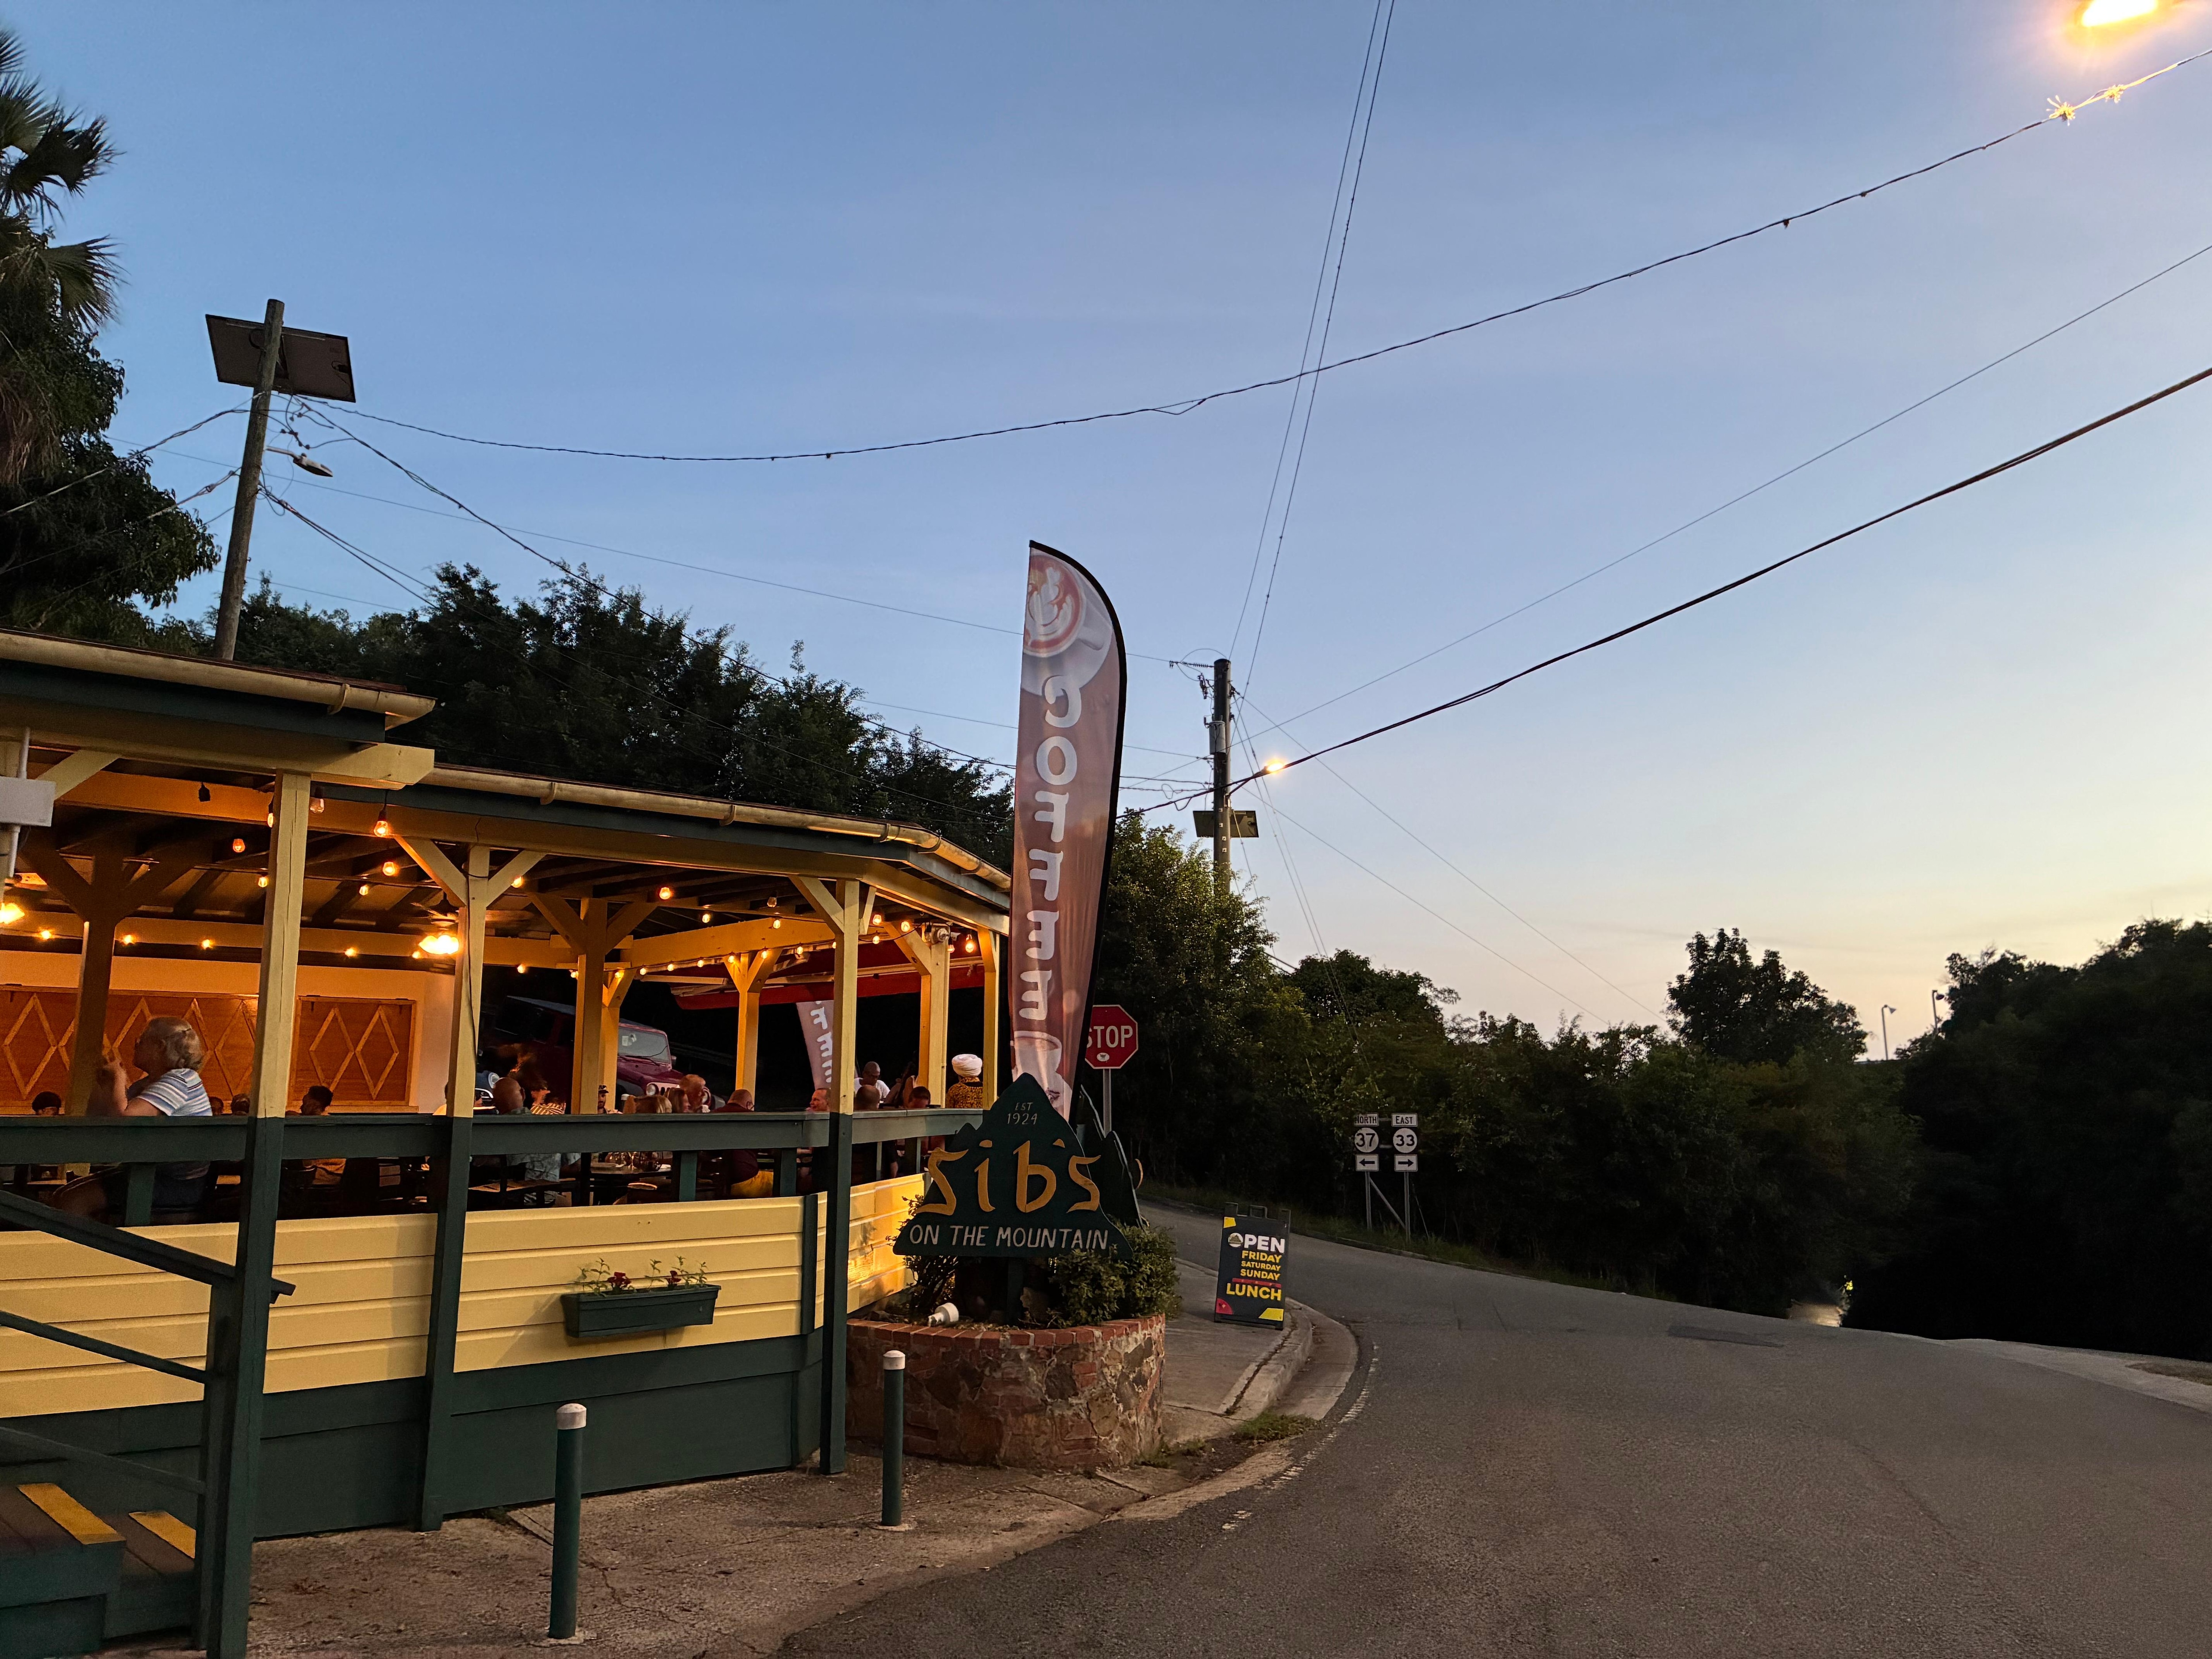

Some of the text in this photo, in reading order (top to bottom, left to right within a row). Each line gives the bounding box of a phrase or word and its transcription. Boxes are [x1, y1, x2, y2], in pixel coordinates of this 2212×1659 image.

[1015, 1102, 1033, 1111] EST
[1007, 1113, 1037, 1125] 1924
[1396, 1115, 1413, 1124] EAST
[1356, 1133, 1375, 1147] 37
[1396, 1134, 1415, 1147] 33
[910, 1225, 1108, 1250] ON THE MOUNTAIN
[1228, 1233, 1285, 1253] OPEN
[1241, 1250, 1282, 1263] FRIDAY
[1241, 1261, 1281, 1271] SATURDAY
[1240, 1269, 1280, 1281] SUNDAY
[1226, 1283, 1282, 1301] LUNCH
